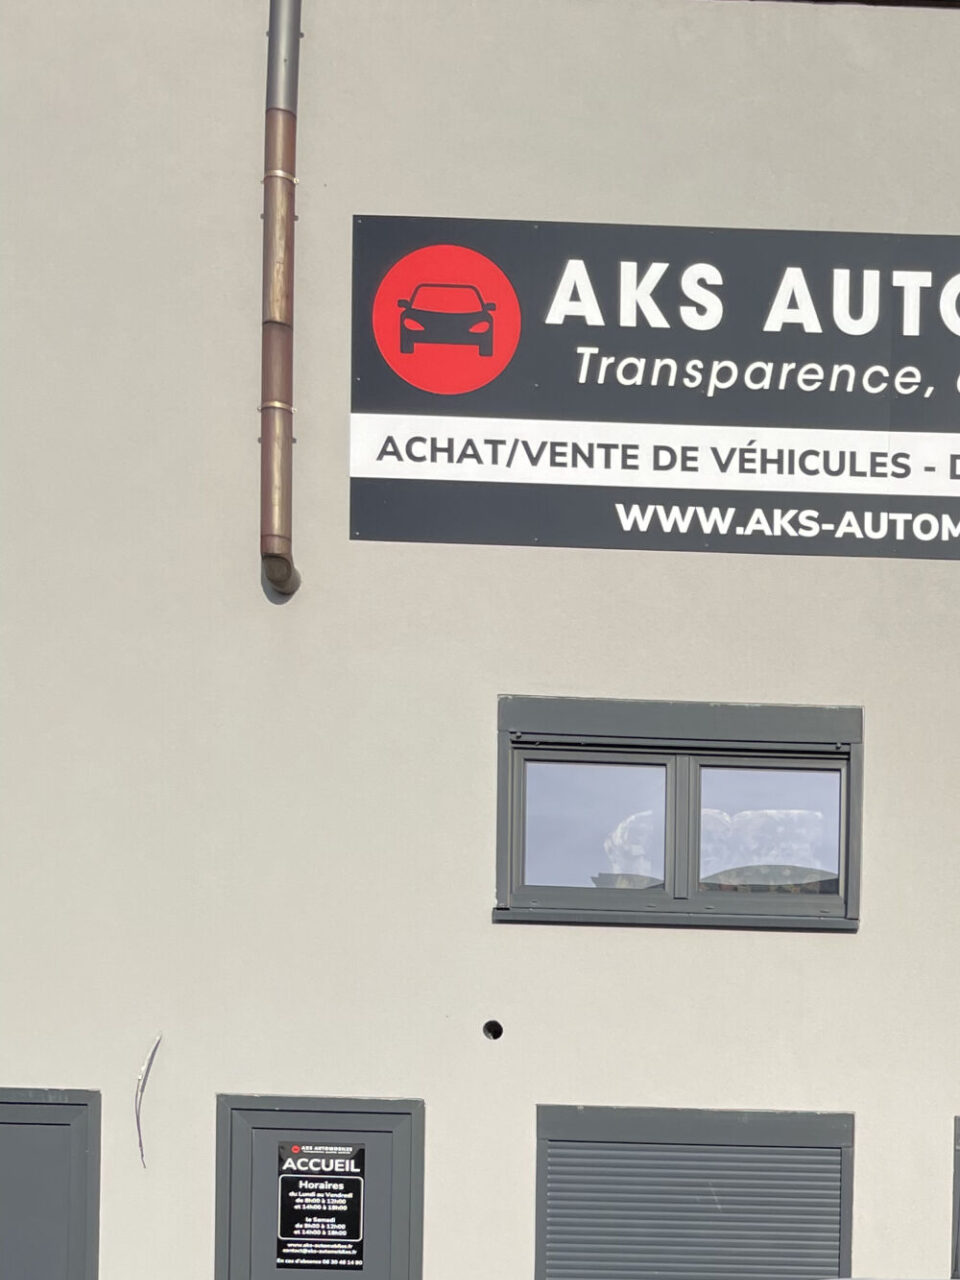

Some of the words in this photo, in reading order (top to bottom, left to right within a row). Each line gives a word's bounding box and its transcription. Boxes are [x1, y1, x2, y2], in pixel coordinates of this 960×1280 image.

[544, 258, 725, 331] AKS
[575, 345, 936, 399] Transparence,
[375, 435, 640, 470] ACHAT/VENTE
[652, 445, 700, 472] DE
[710, 440, 912, 479] VÉHICULES
[282, 1157, 361, 1172] ACCUEIL
[299, 1180, 345, 1190] Horaires
